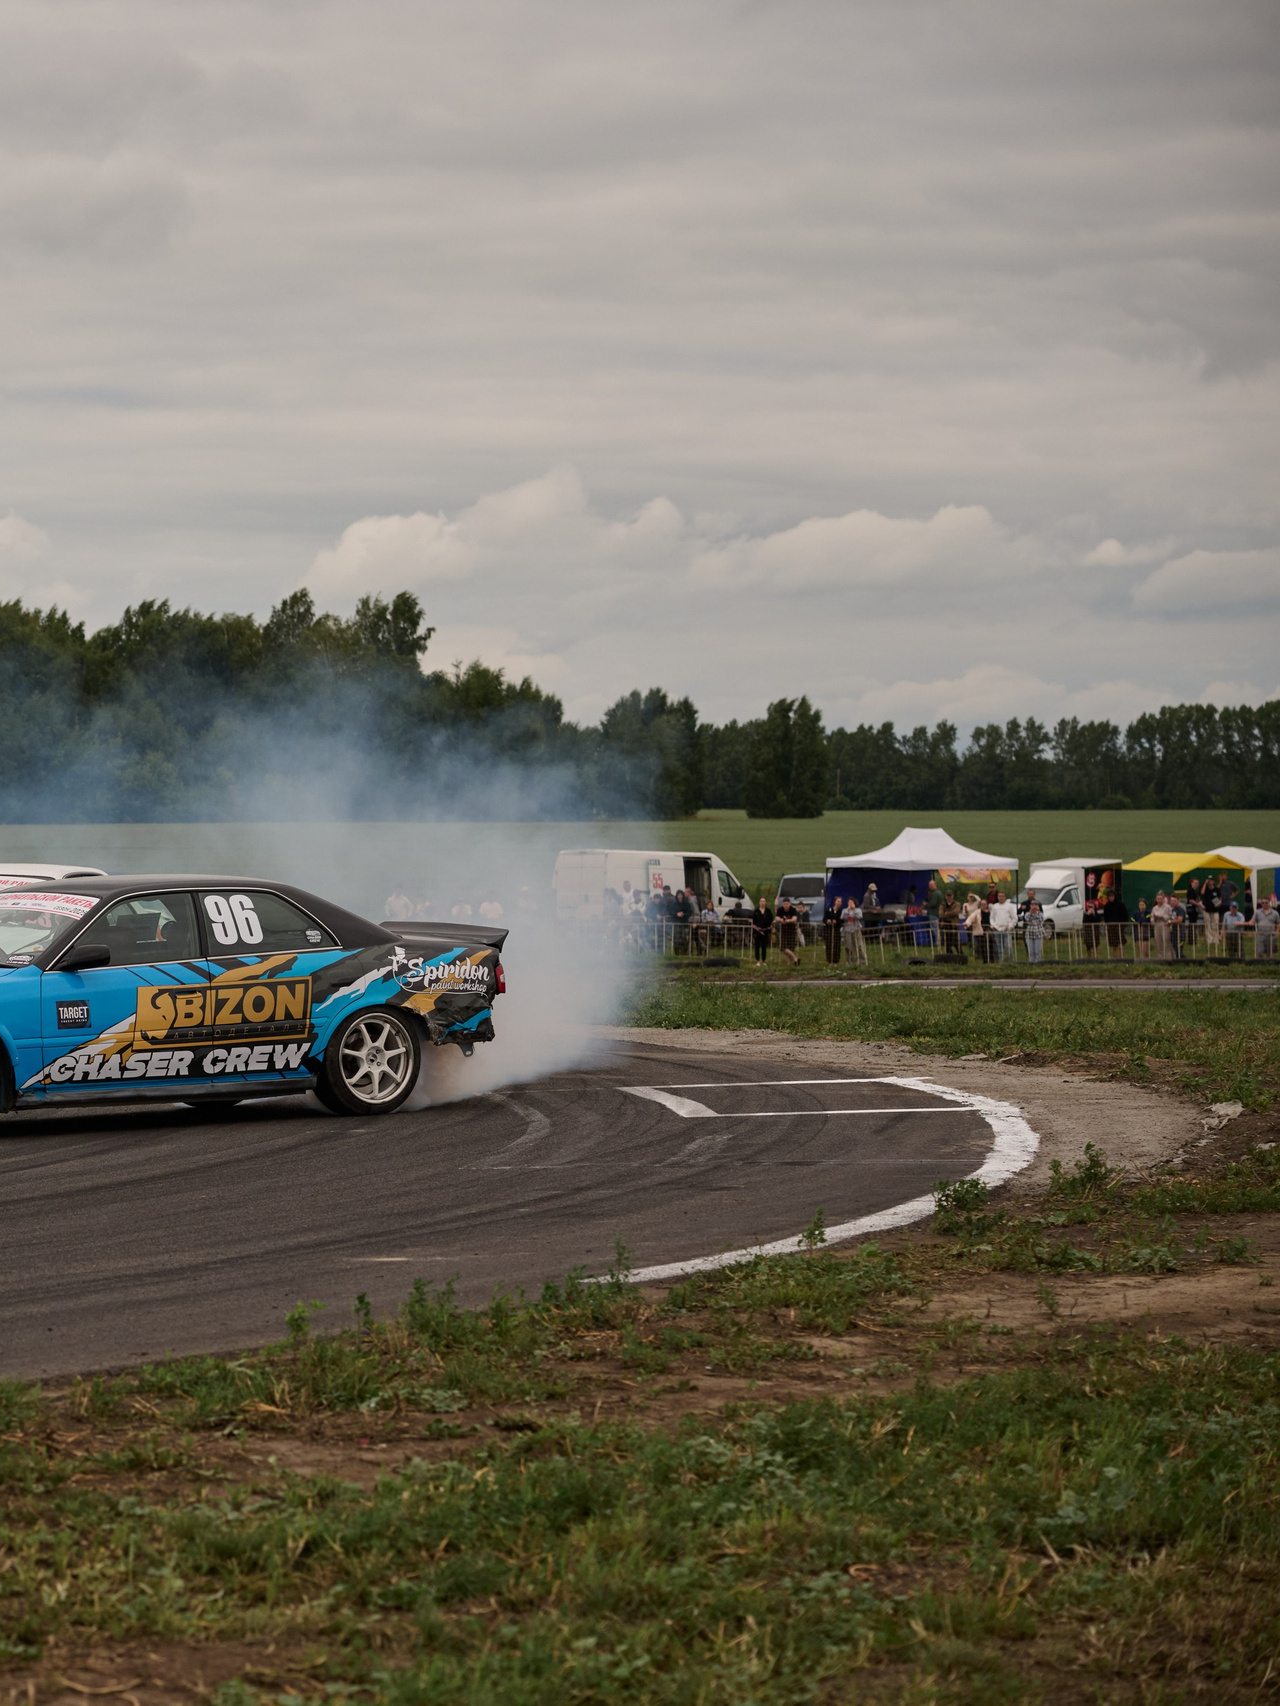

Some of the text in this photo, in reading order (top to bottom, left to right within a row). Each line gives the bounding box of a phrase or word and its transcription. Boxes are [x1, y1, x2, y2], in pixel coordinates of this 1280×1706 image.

[204, 894, 264, 945] 96
[407, 956, 490, 988] Spiridon
[429, 979, 488, 997] paint workshop
[58, 1006, 89, 1020] TARGET
[173, 983, 306, 1029] BIZON
[173, 1023, 304, 1040] АВТОДЕТАЛЬ
[49, 1042, 312, 1082] CHASER CREW
